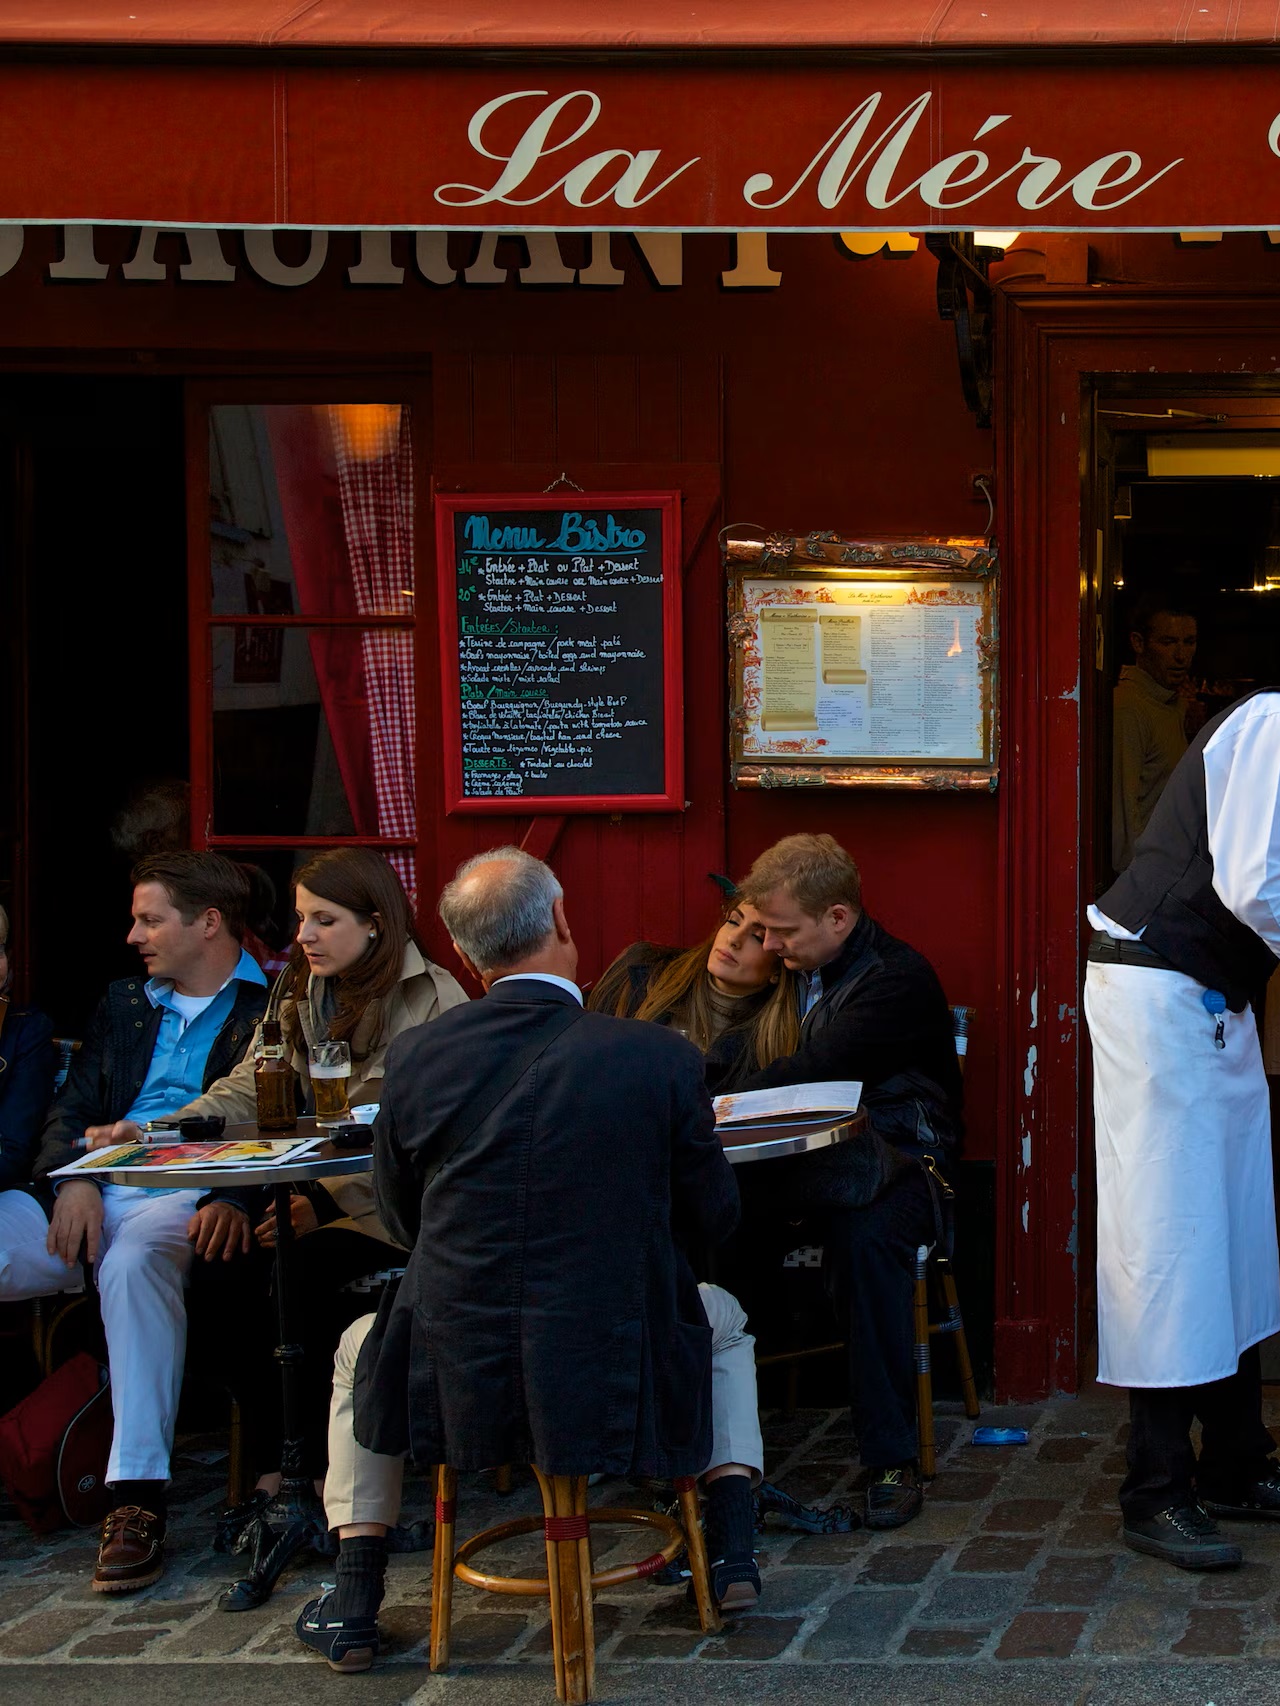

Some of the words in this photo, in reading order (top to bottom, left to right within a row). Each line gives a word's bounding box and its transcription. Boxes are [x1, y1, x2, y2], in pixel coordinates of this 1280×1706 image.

[433, 88, 701, 210] La
[742, 91, 1184, 212] Mére
[464, 515, 547, 550] Menu
[545, 512, 646, 552] Bistro
[486, 556, 516, 573] Entrée
[527, 558, 550, 573] Plat
[571, 557, 594, 573] Plat
[523, 589, 544, 602] Plat
